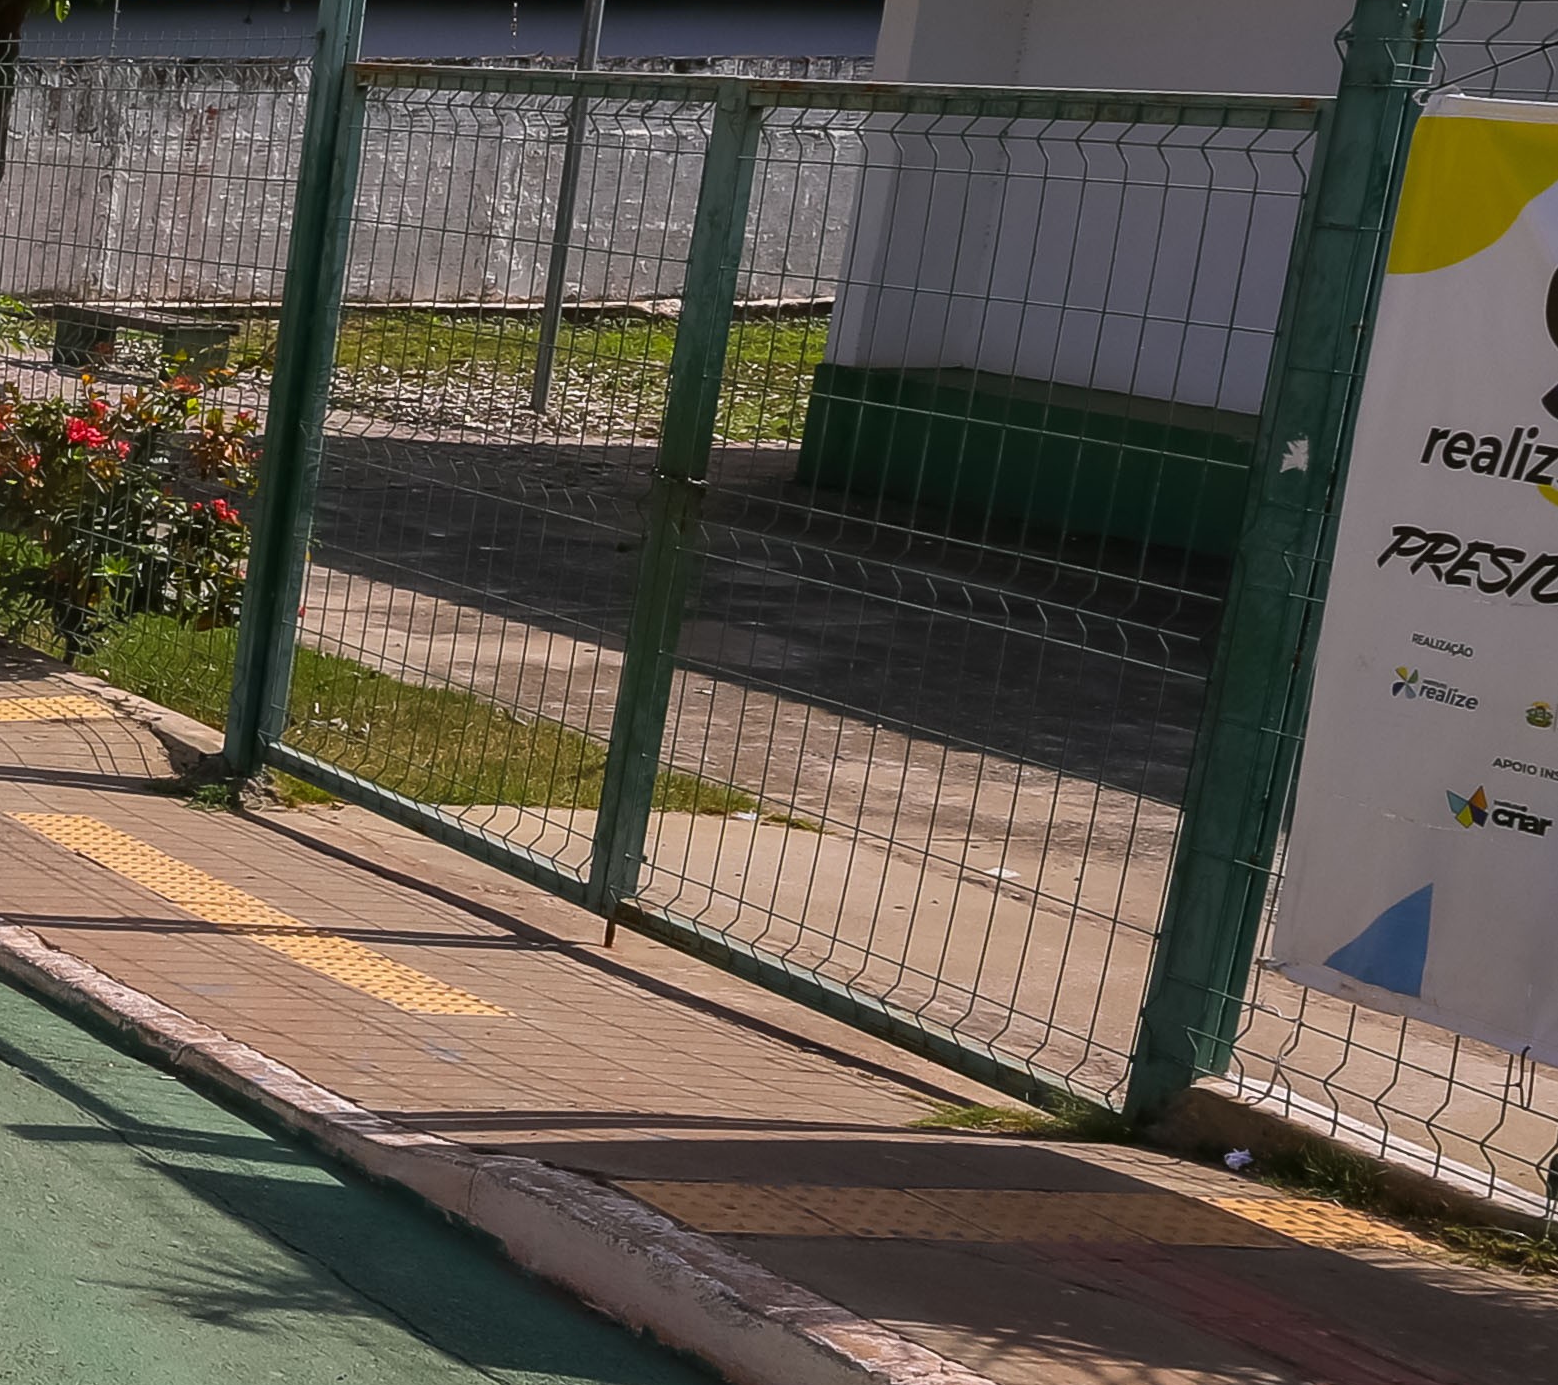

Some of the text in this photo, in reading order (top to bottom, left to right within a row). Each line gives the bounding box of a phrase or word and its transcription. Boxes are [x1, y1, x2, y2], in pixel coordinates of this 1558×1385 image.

[1420, 426, 1558, 486] realiz
[1411, 633, 1474, 657] REALIZAÇÃO
[1419, 684, 1479, 710] realize
[1492, 758, 1538, 775] APOIO
